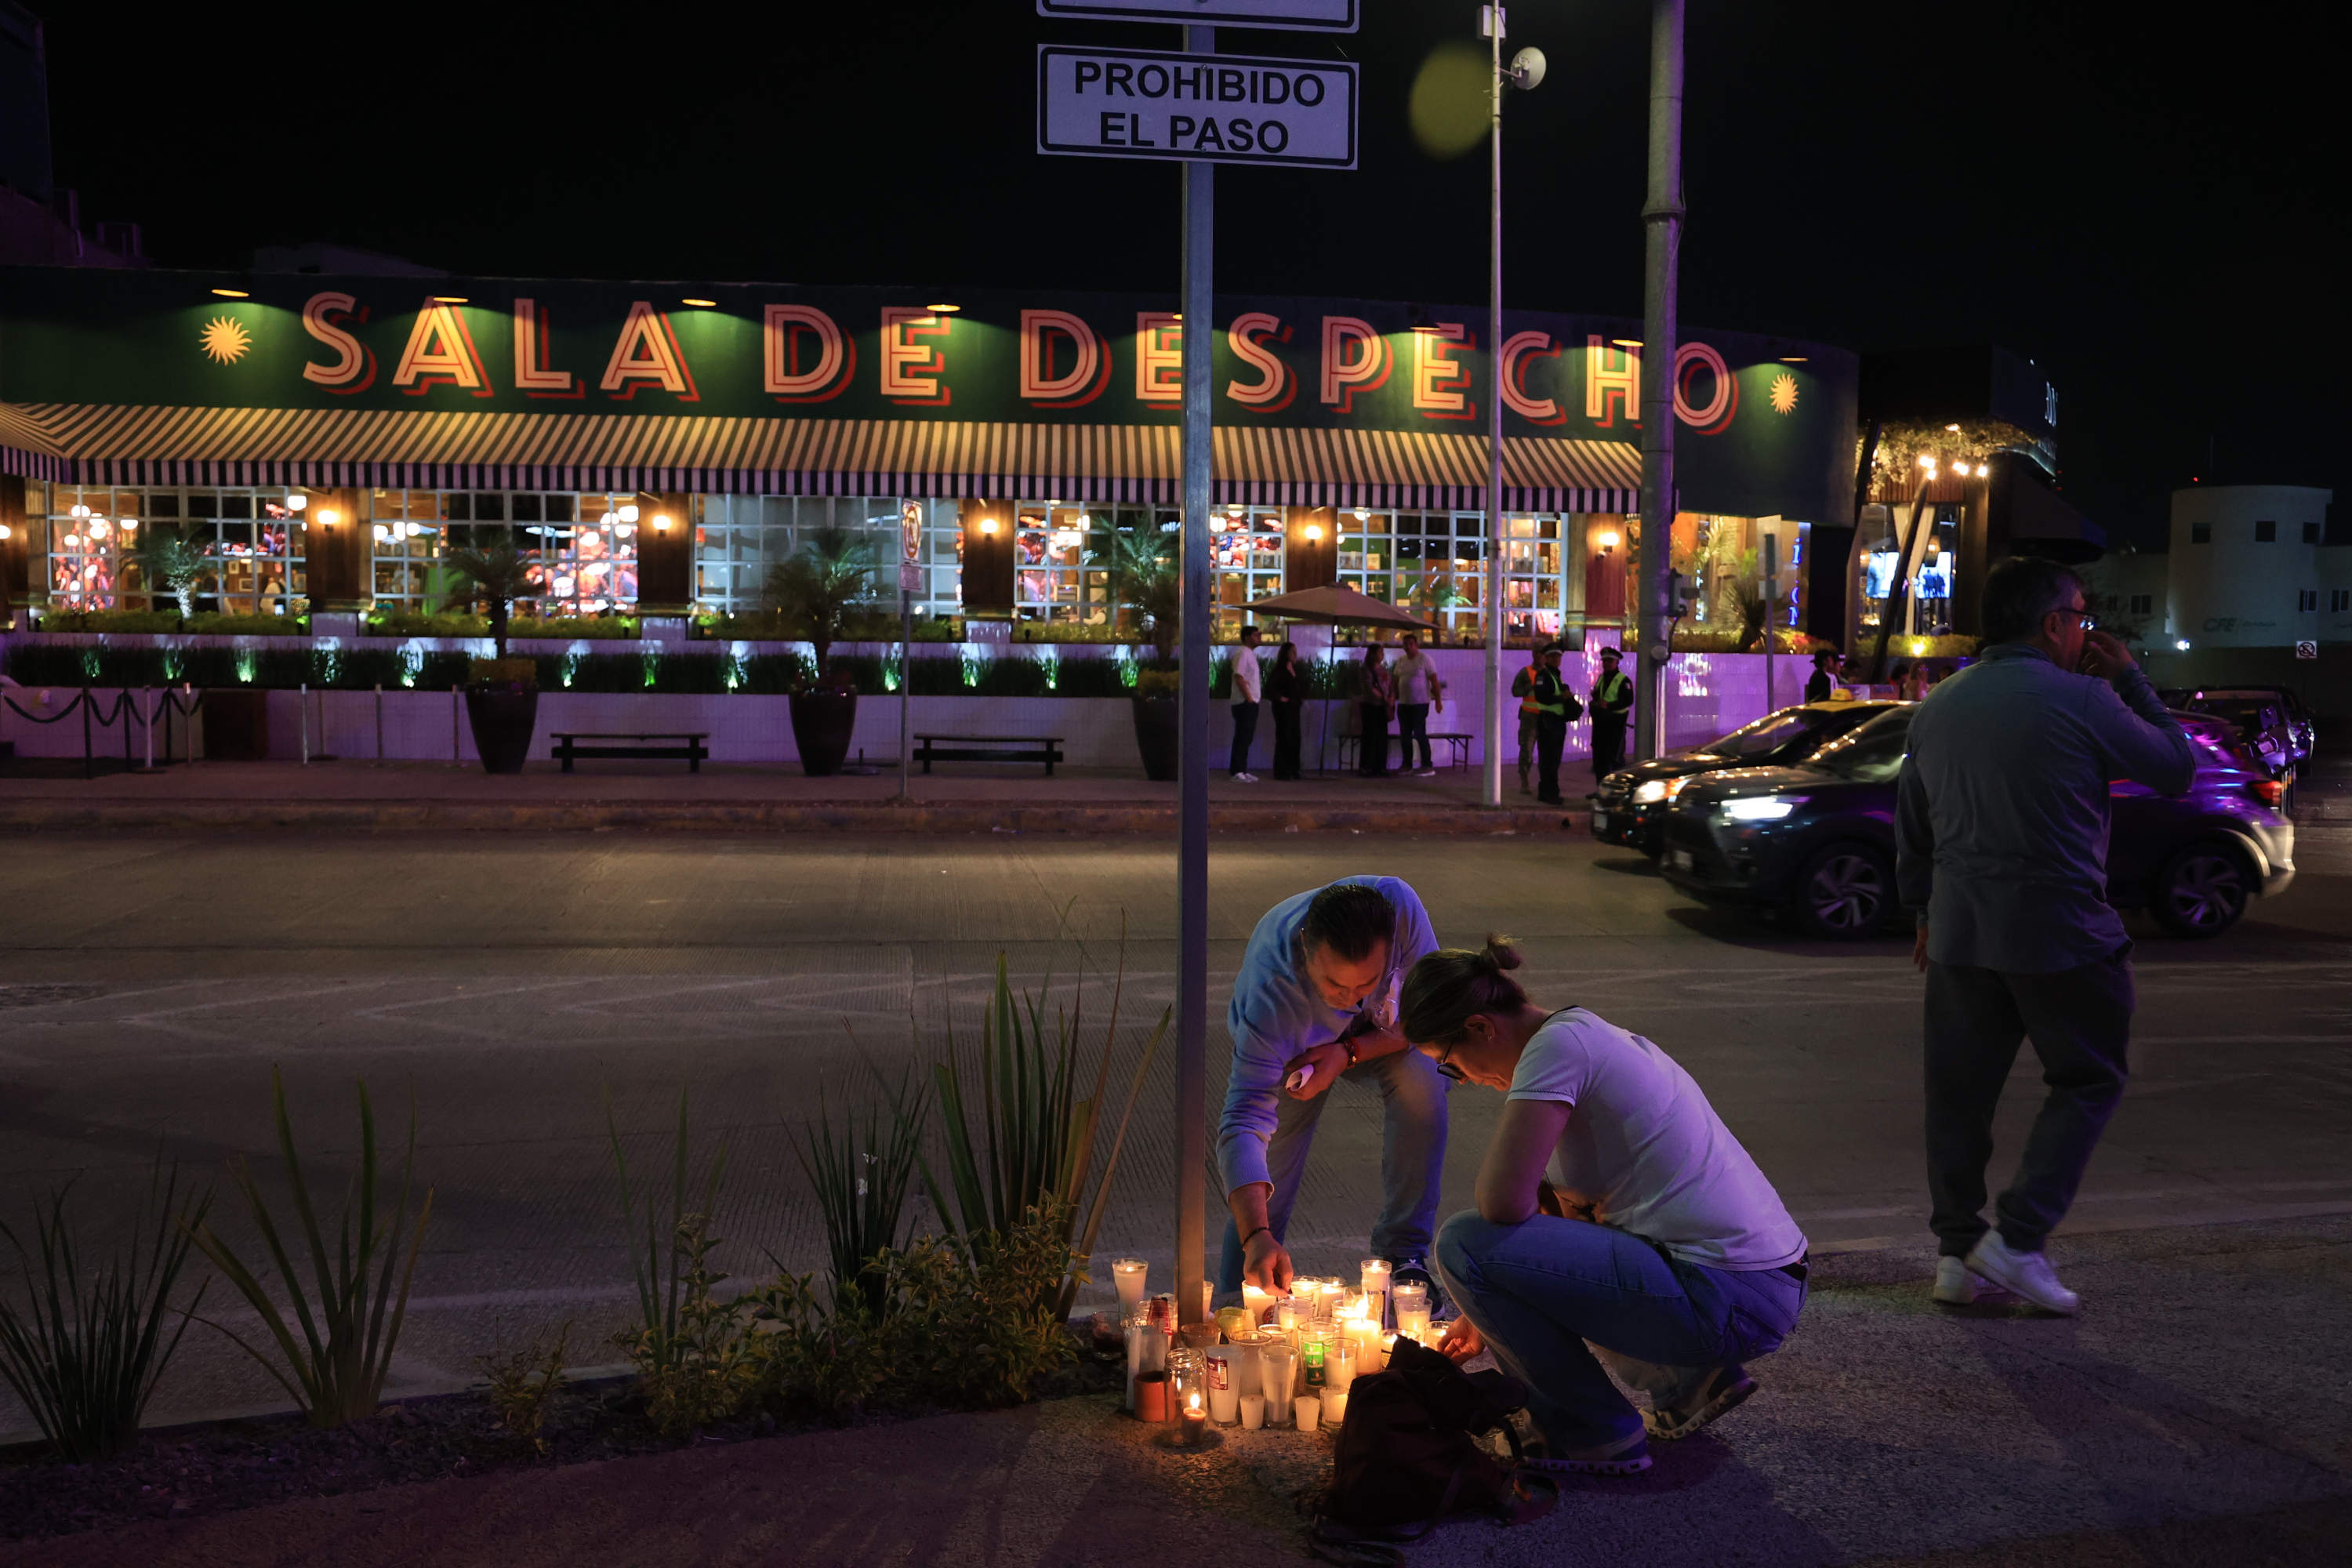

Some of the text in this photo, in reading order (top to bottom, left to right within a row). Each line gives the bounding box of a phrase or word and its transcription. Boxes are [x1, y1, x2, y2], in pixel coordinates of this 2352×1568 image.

[1074, 60, 1325, 107] PROHIBIDO
[1099, 111, 1289, 154] EL PASO
[303, 291, 1740, 436] SALA DE DESPECHO
